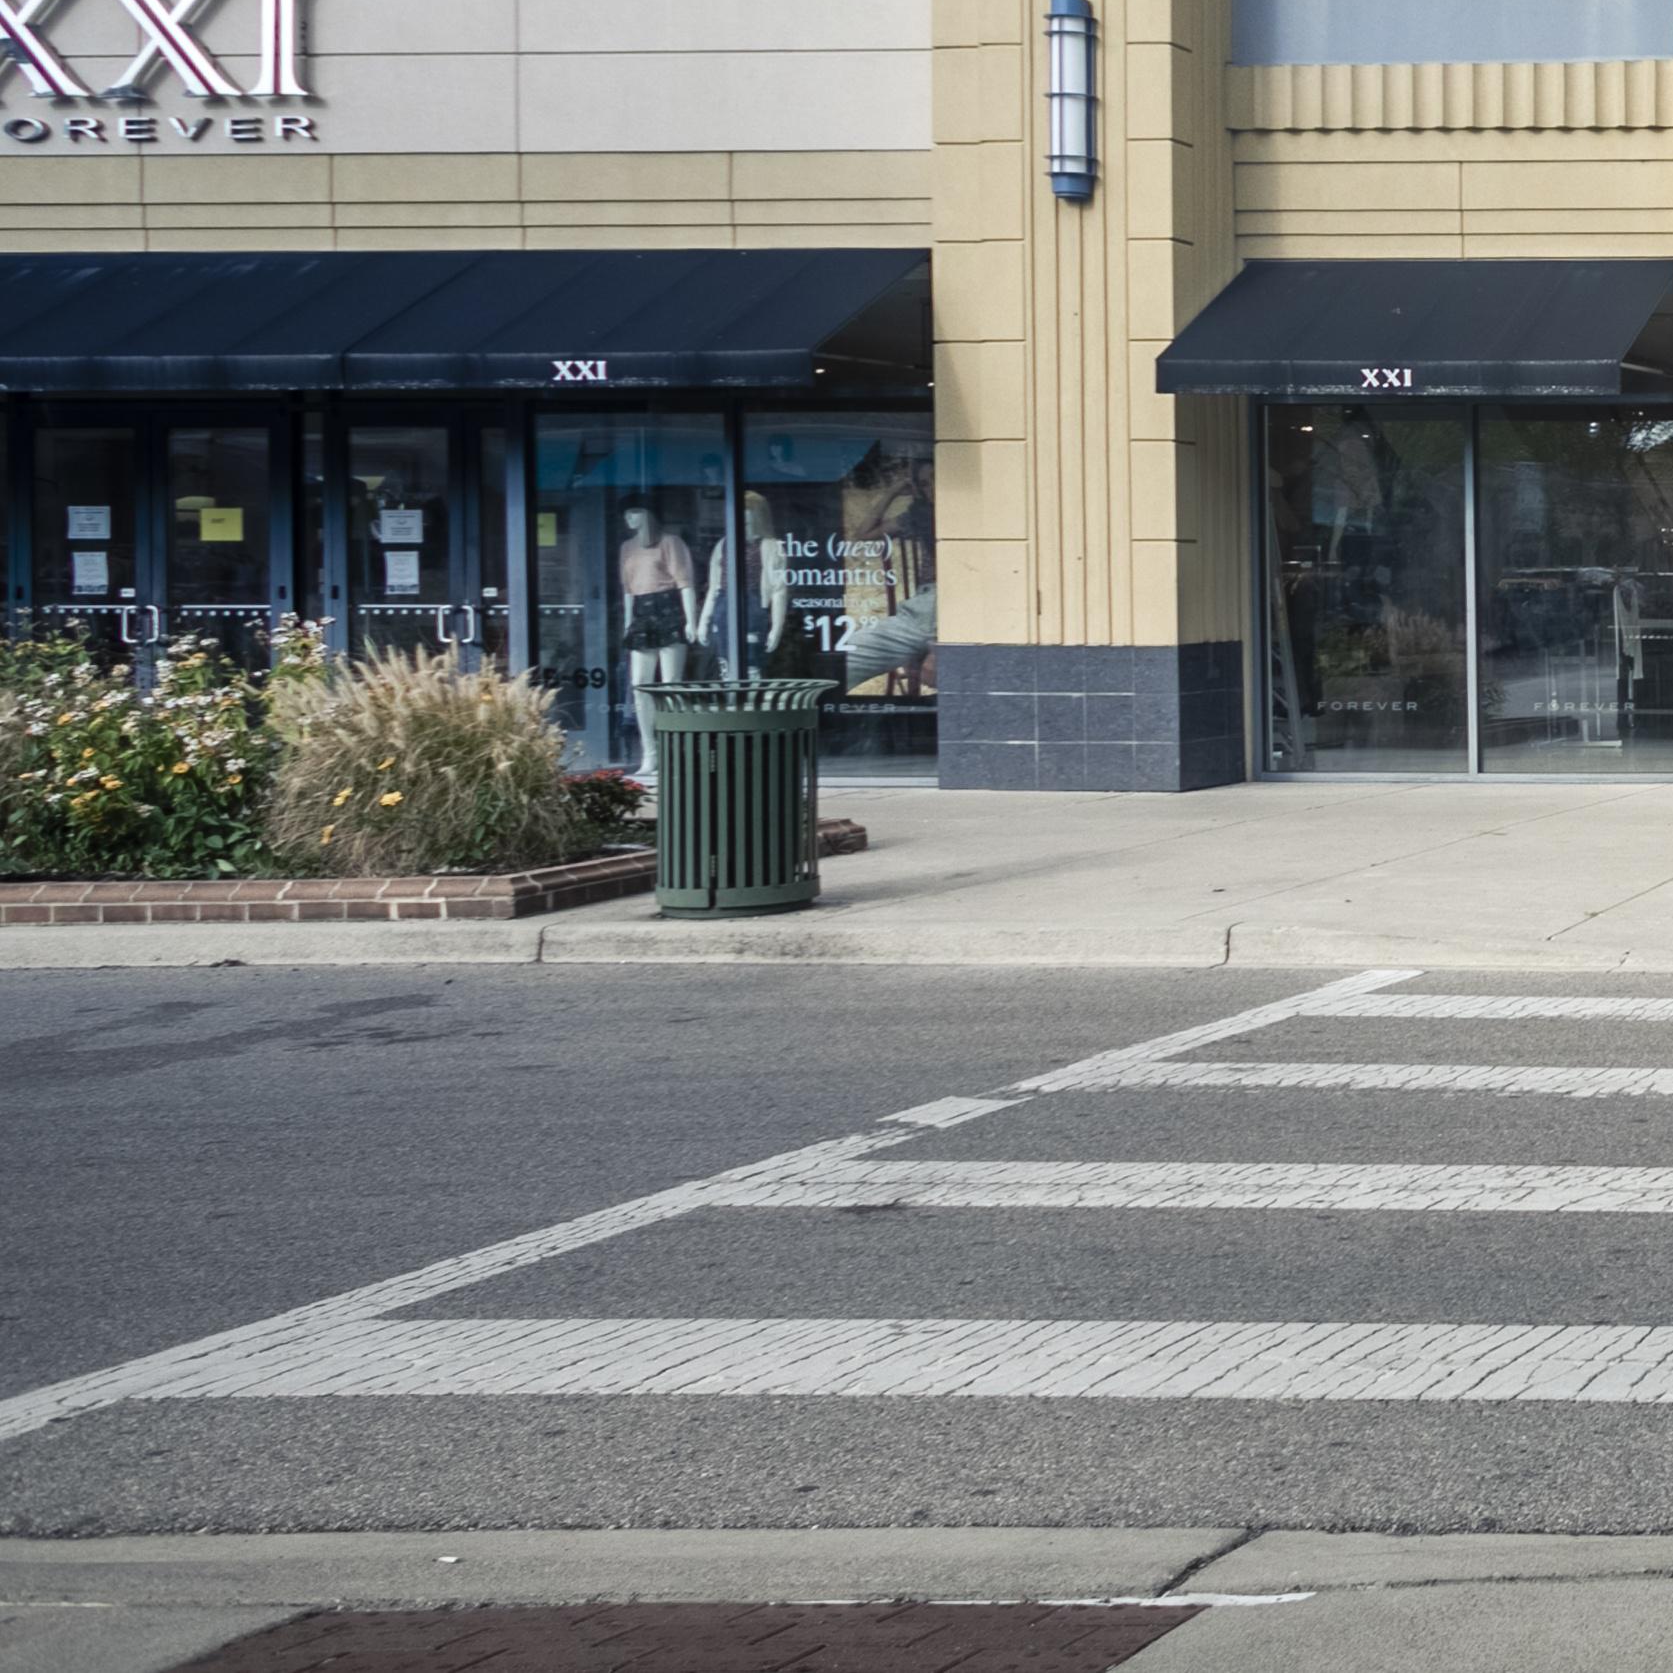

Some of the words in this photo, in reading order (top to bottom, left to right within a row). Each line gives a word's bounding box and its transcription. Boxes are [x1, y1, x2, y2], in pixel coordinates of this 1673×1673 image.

[4, 116, 320, 142] OREVER
[551, 359, 608, 381] XXI
[1360, 368, 1412, 388] XXI
[776, 532, 819, 558] the
[823, 703, 897, 714] REVER
[1316, 701, 1418, 711] FOREVER
[1533, 702, 1636, 711] FOREVER
